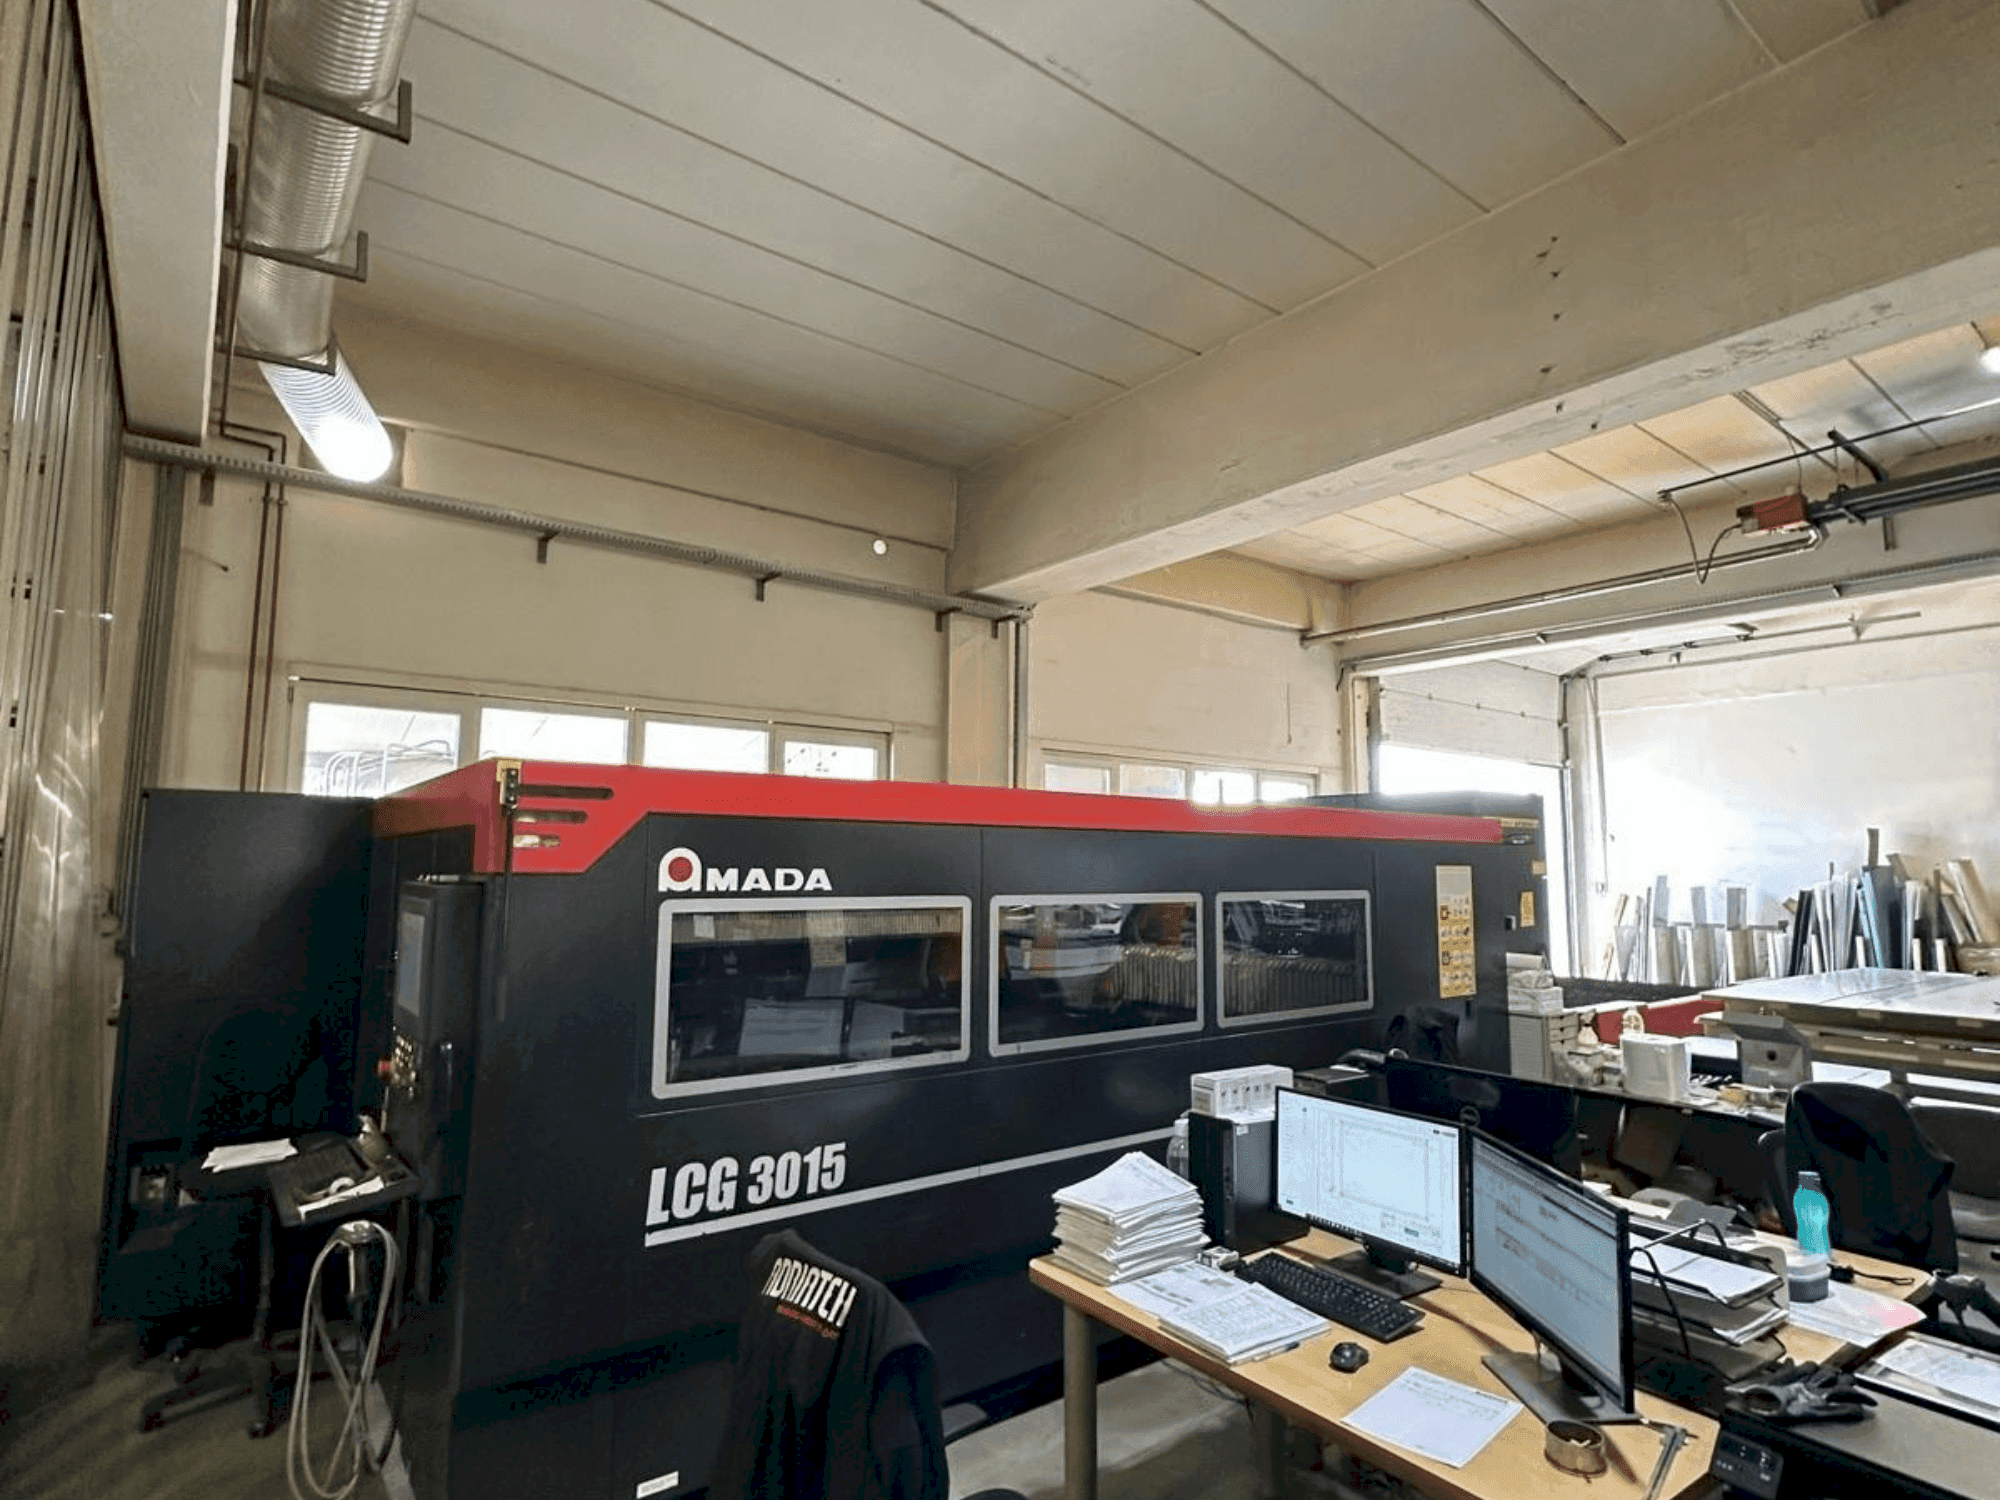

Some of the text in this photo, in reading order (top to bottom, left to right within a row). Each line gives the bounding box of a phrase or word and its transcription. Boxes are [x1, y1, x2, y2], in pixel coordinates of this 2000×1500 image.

[658, 847, 832, 892] AMADA
[646, 1142, 846, 1226] LCG 3015
